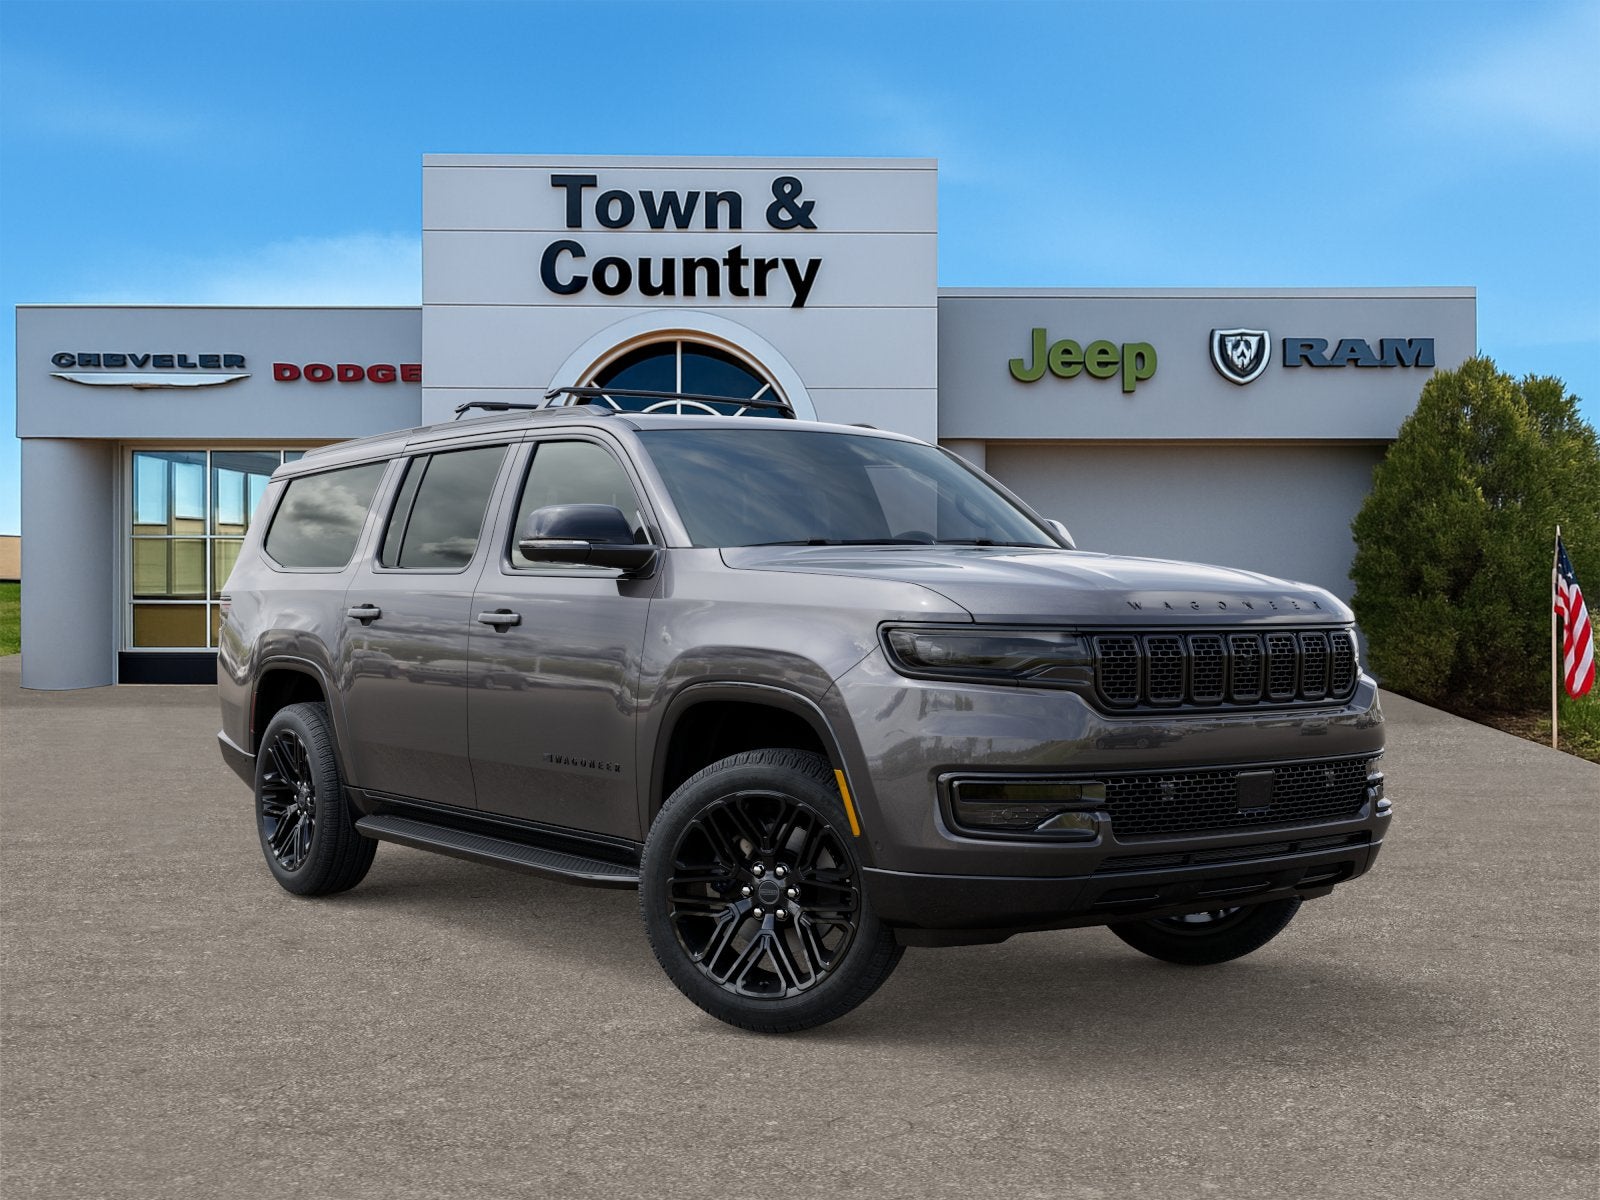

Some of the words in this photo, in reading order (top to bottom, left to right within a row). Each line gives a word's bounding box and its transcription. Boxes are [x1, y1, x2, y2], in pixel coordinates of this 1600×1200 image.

[551, 174, 743, 230] Town
[765, 175, 818, 230] &
[540, 239, 822, 308] Country
[273, 363, 422, 383] DODGE
[1009, 328, 1157, 393] Jeep
[1282, 337, 1436, 368] RAM
